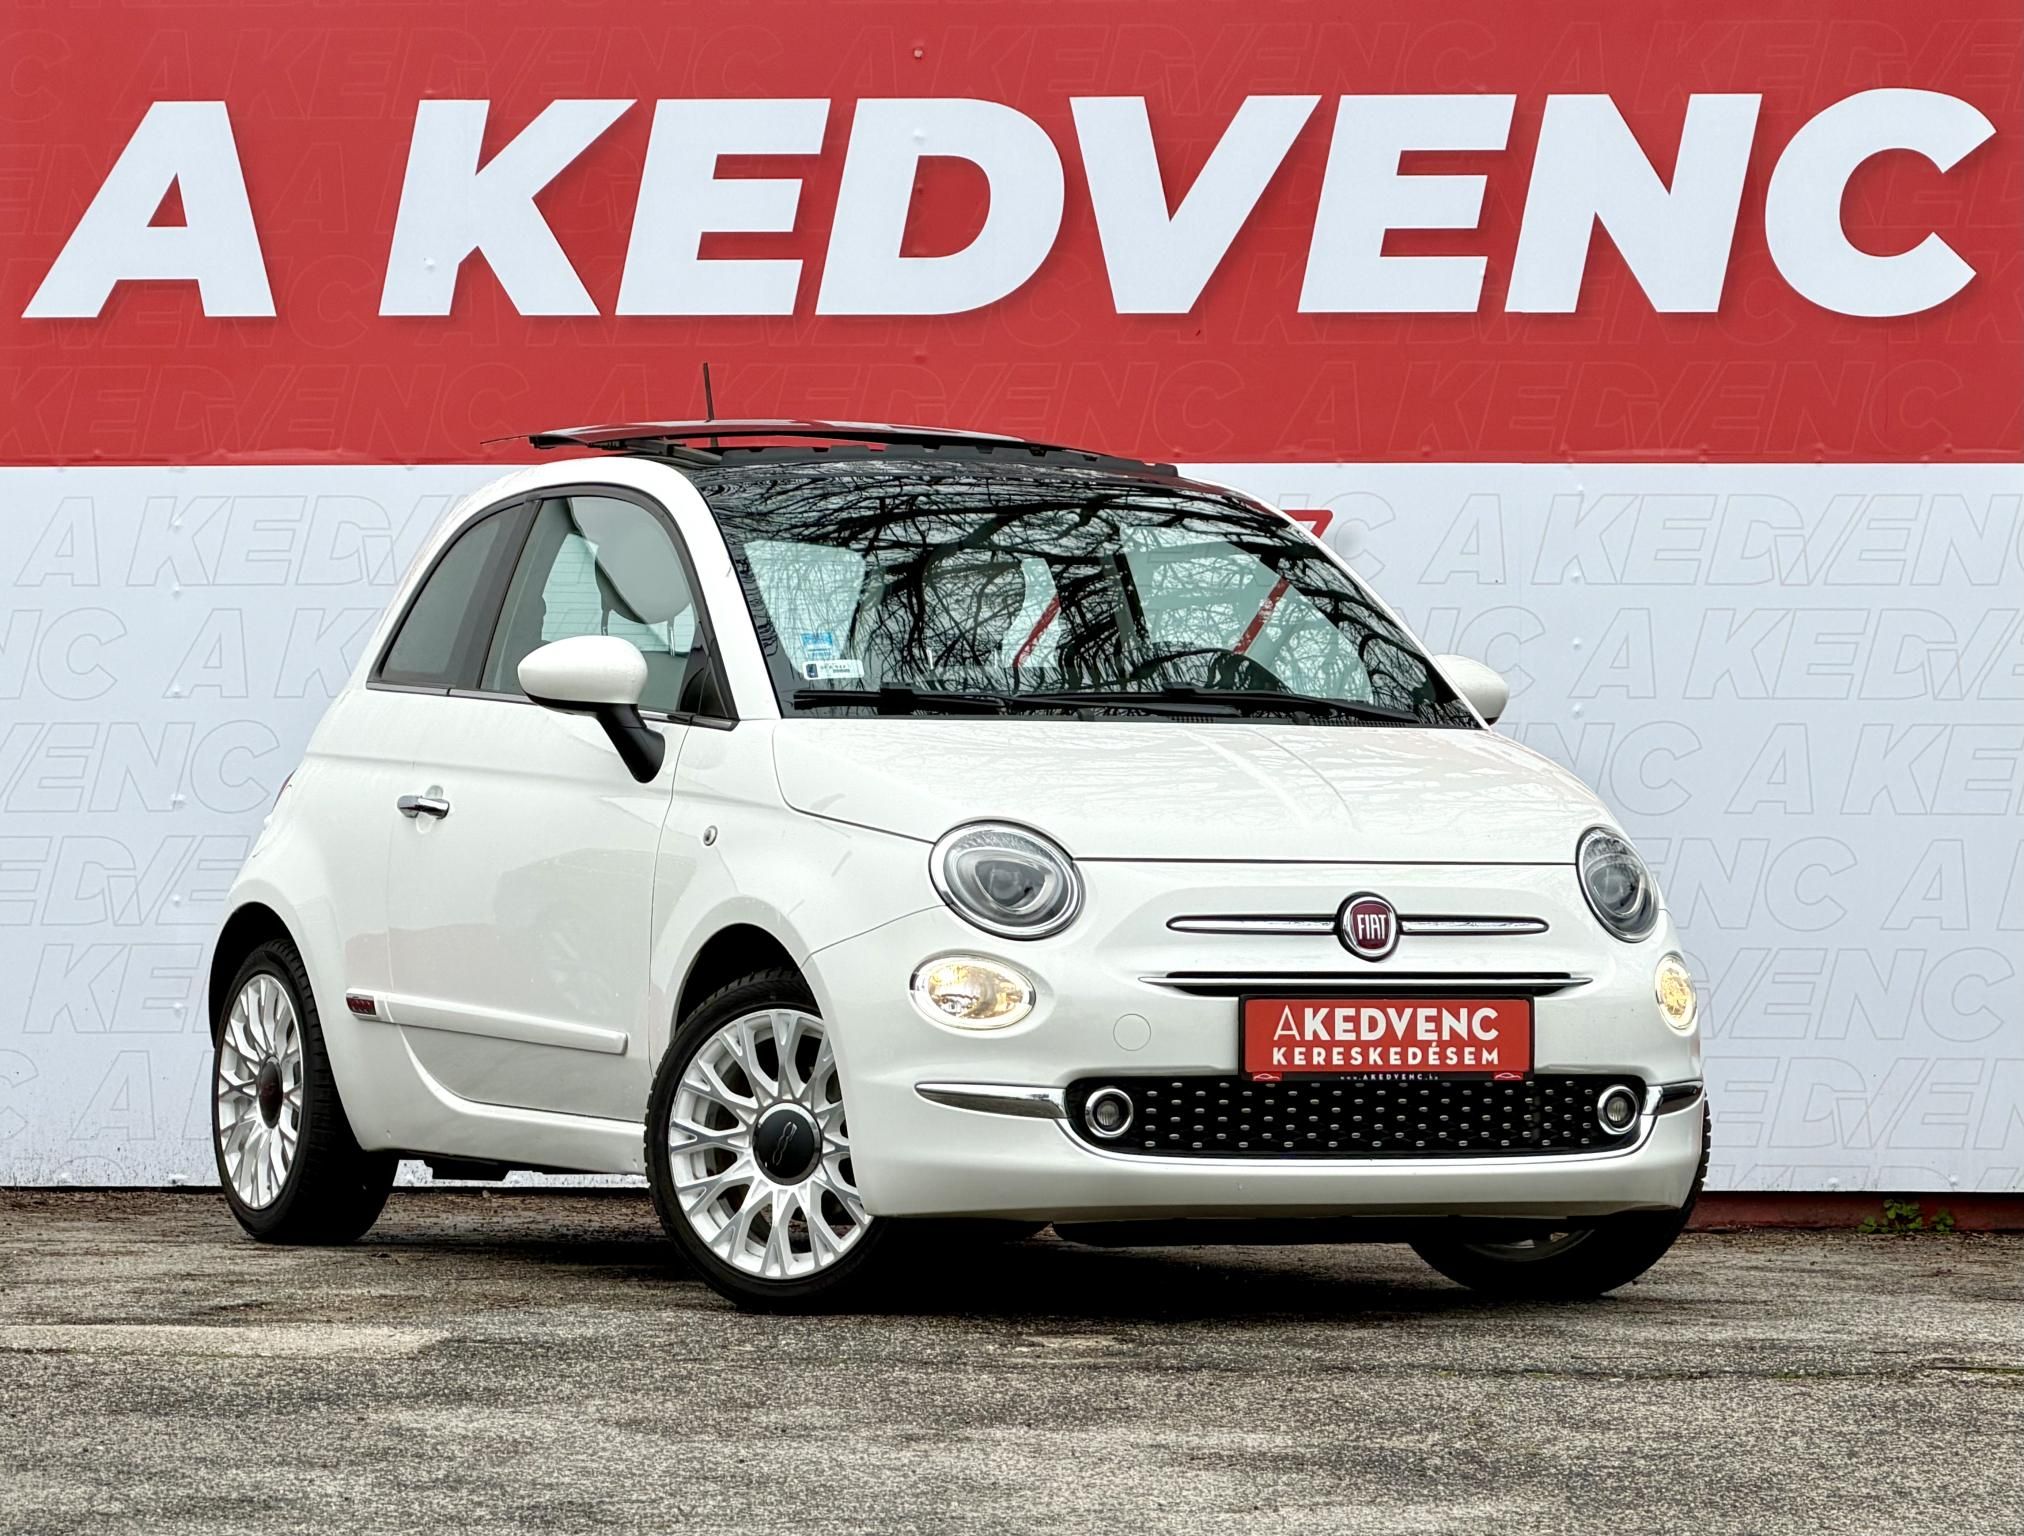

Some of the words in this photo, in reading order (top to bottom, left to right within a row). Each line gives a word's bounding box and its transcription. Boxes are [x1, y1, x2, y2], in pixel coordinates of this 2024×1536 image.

[20, 100, 277, 319] A
[378, 87, 1998, 318] KEDVENC
[1530, 493, 2024, 586] KEDVEN
[1356, 914, 1387, 940] FIAT
[1272, 1042, 1499, 1066] KERESKEDÉSEM
